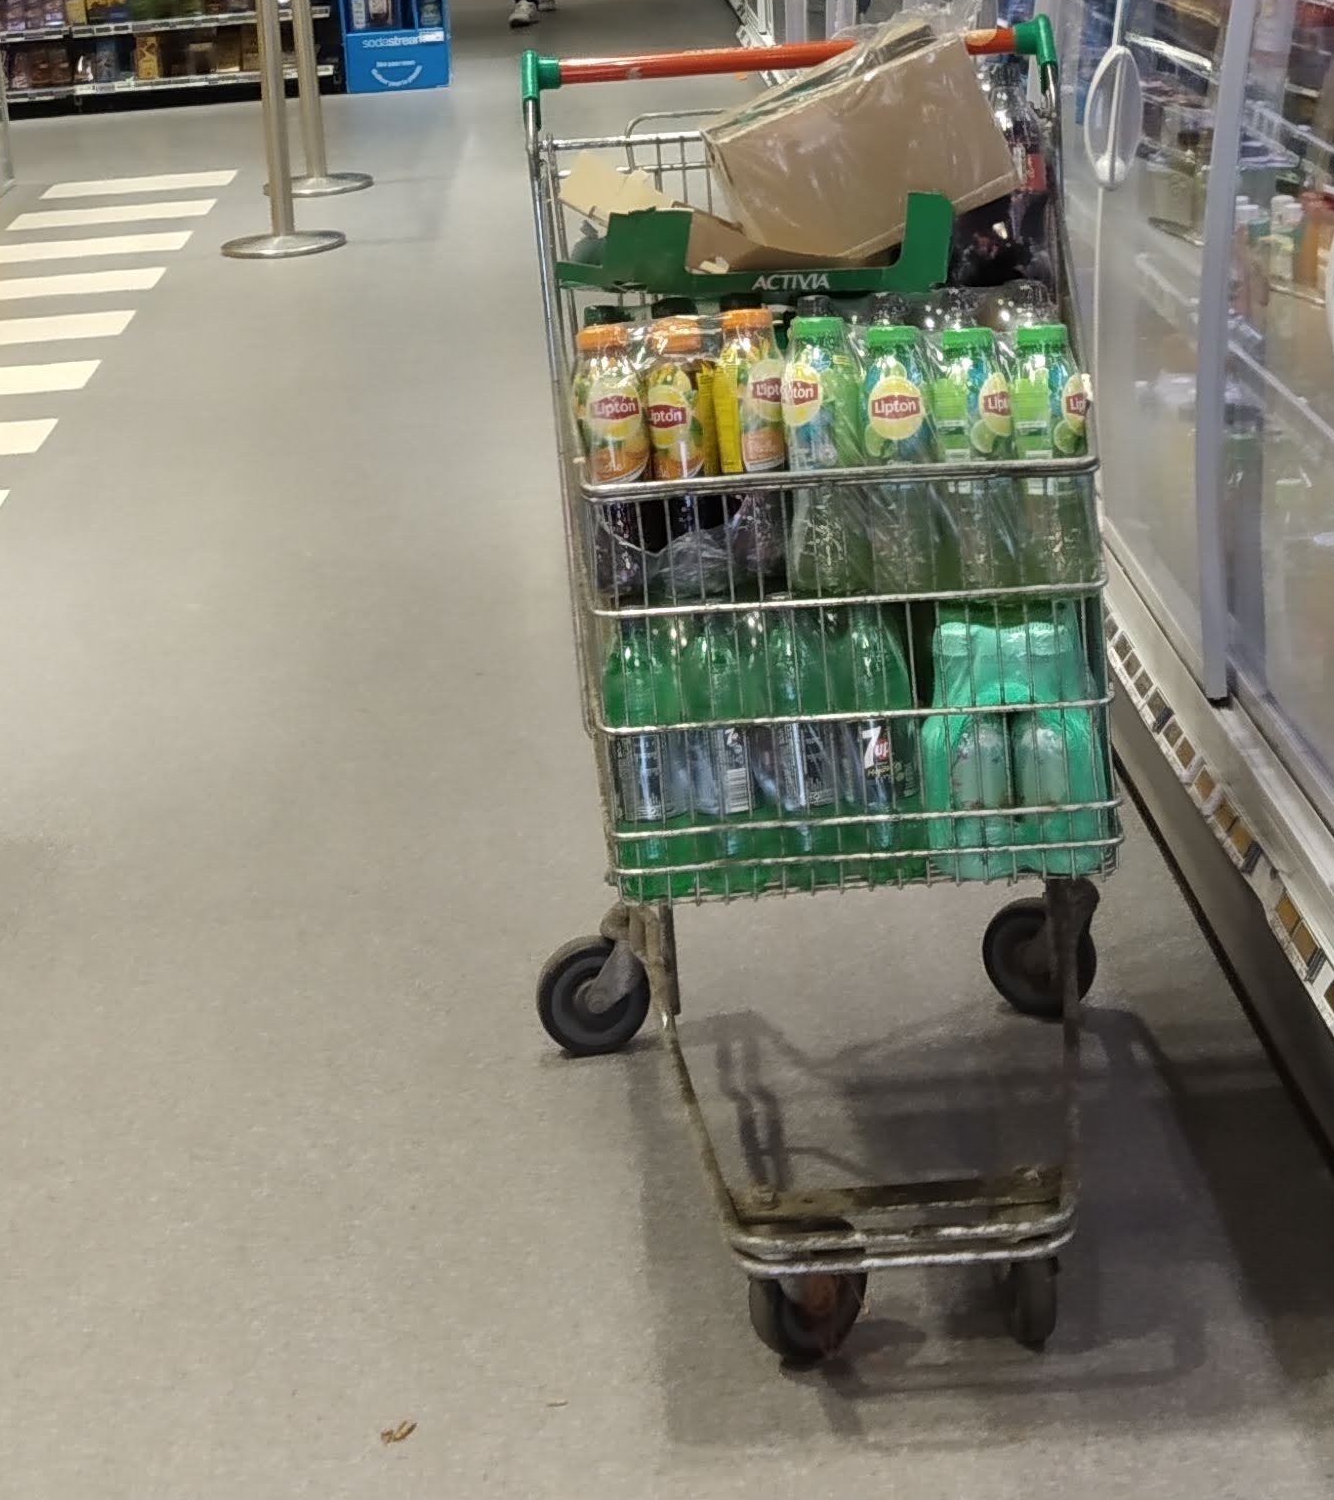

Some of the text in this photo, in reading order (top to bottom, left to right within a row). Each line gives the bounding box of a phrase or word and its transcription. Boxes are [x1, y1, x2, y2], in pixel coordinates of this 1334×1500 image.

[751, 273, 831, 291] ACTIVIA
[593, 399, 636, 415] Lipton
[873, 400, 917, 415] Lipton
